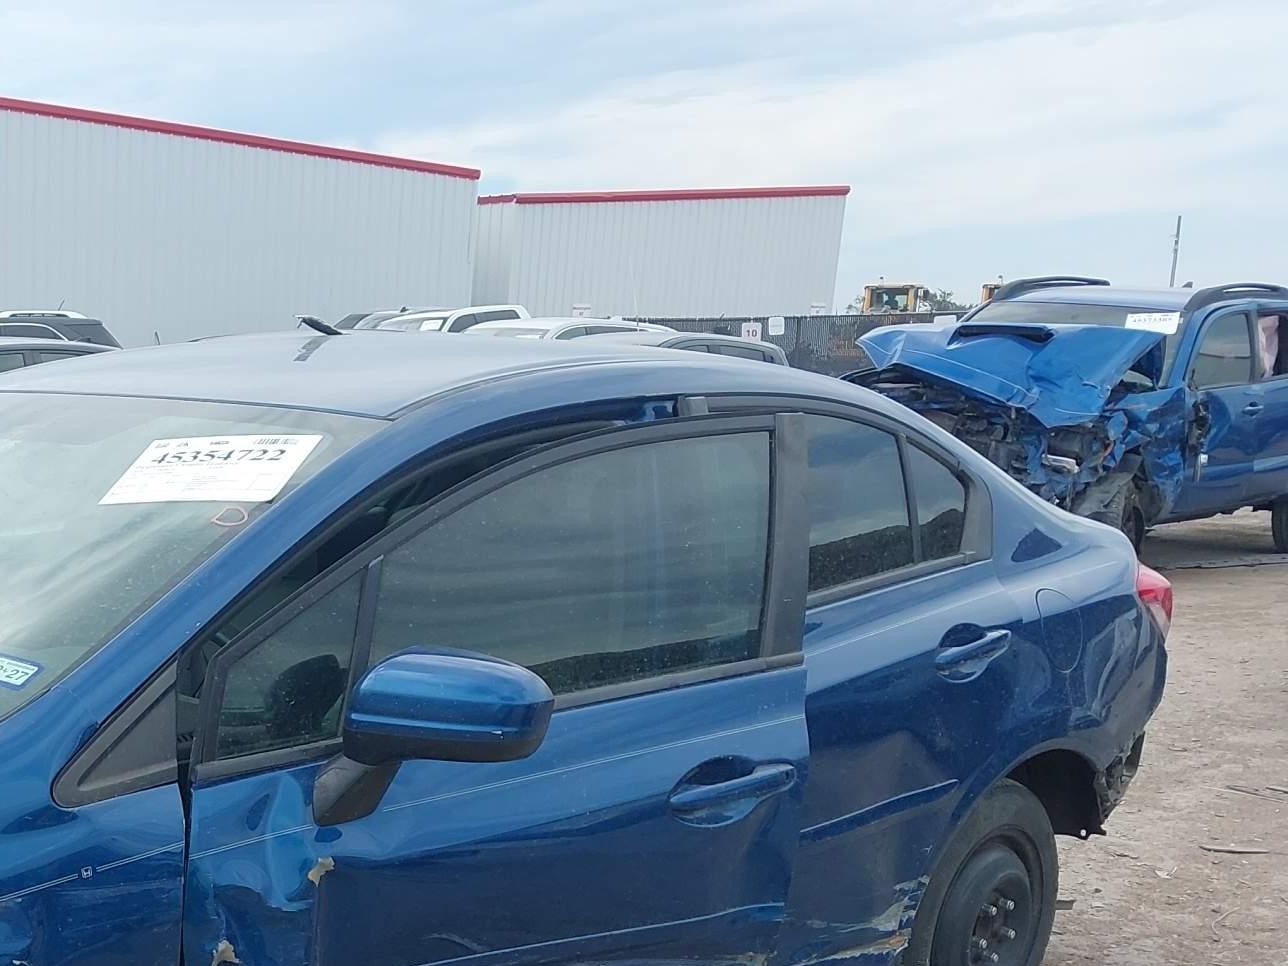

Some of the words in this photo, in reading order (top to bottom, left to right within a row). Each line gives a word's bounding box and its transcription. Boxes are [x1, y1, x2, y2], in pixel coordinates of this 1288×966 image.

[746, 329, 758, 338] 10
[151, 449, 286, 465] 45354722
[5, 669, 29, 681] 27
